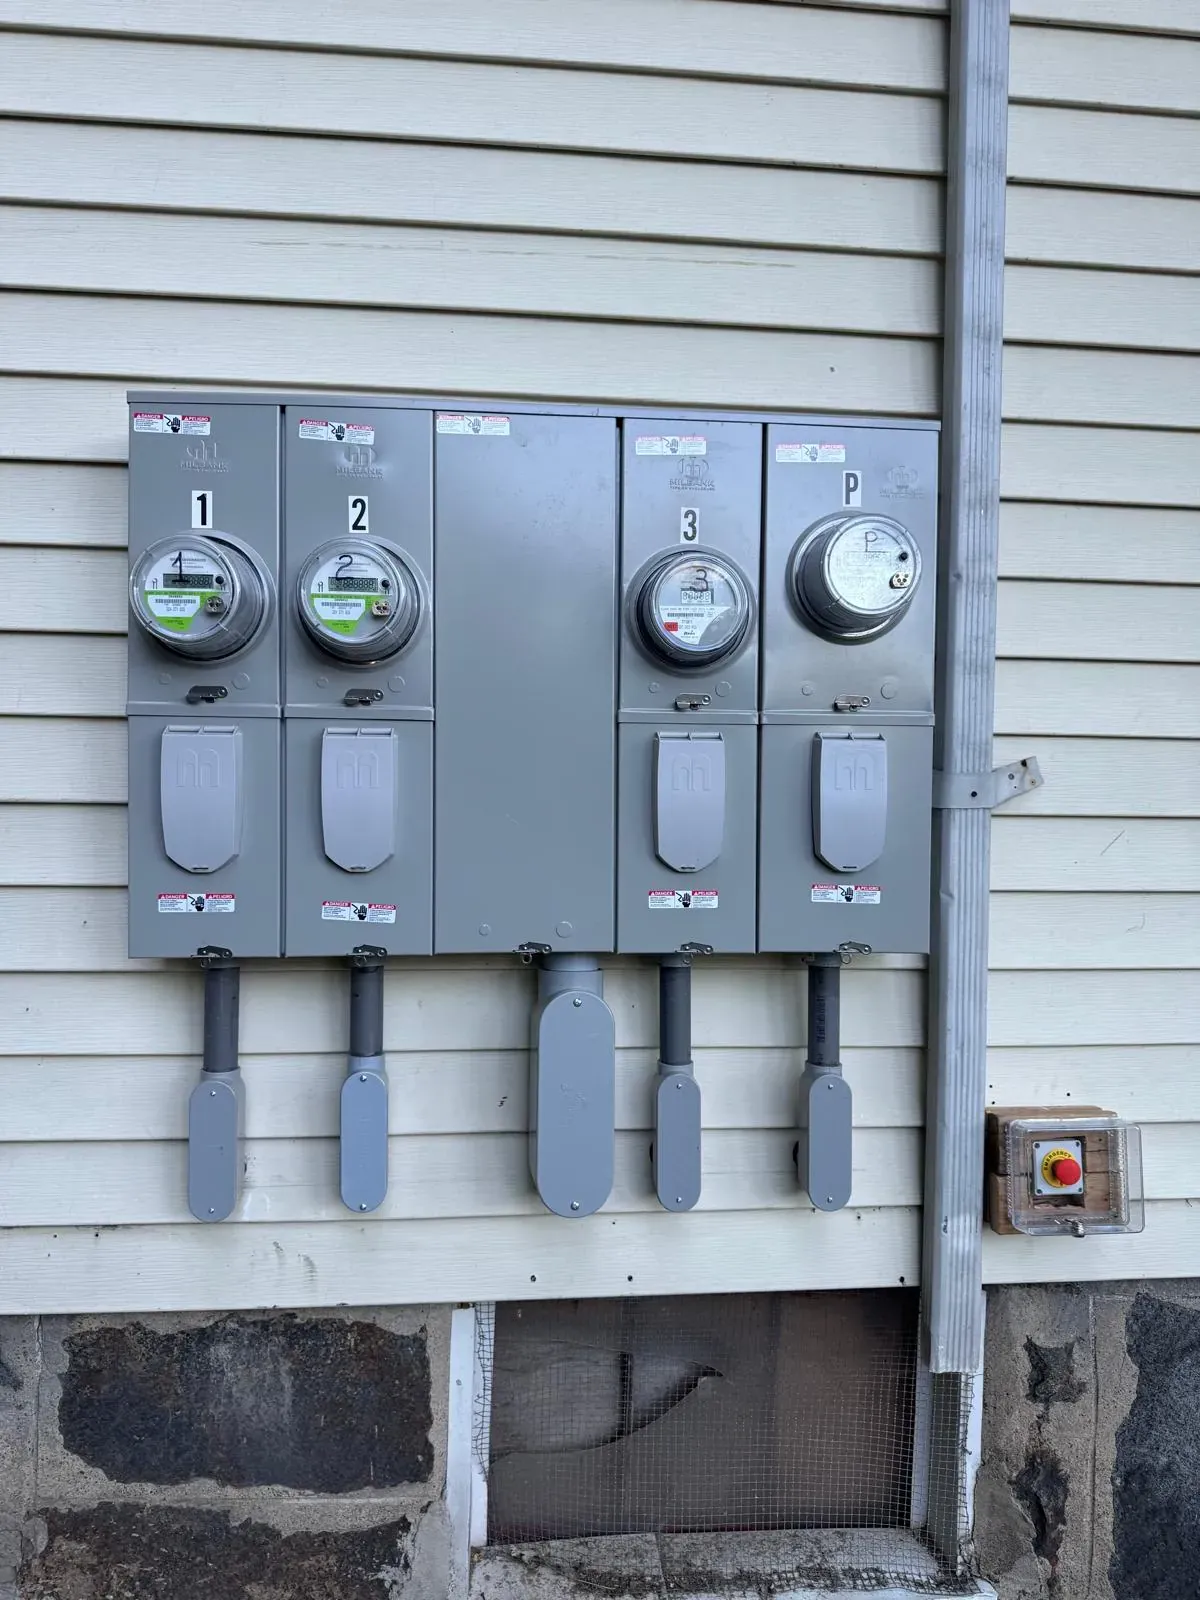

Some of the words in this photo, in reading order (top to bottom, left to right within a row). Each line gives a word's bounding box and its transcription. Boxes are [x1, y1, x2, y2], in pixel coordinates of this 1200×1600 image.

[669, 478, 715, 487] MILBANK
[845, 472, 859, 505] P
[196, 493, 207, 526] 1
[352, 498, 366, 531] 2
[683, 509, 697, 541] 3
[864, 531, 878, 553] P
[171, 551, 191, 583] 1
[335, 554, 354, 581] 2
[689, 568, 709, 592] 3
[1043, 1150, 1072, 1171] EMERGENCY
